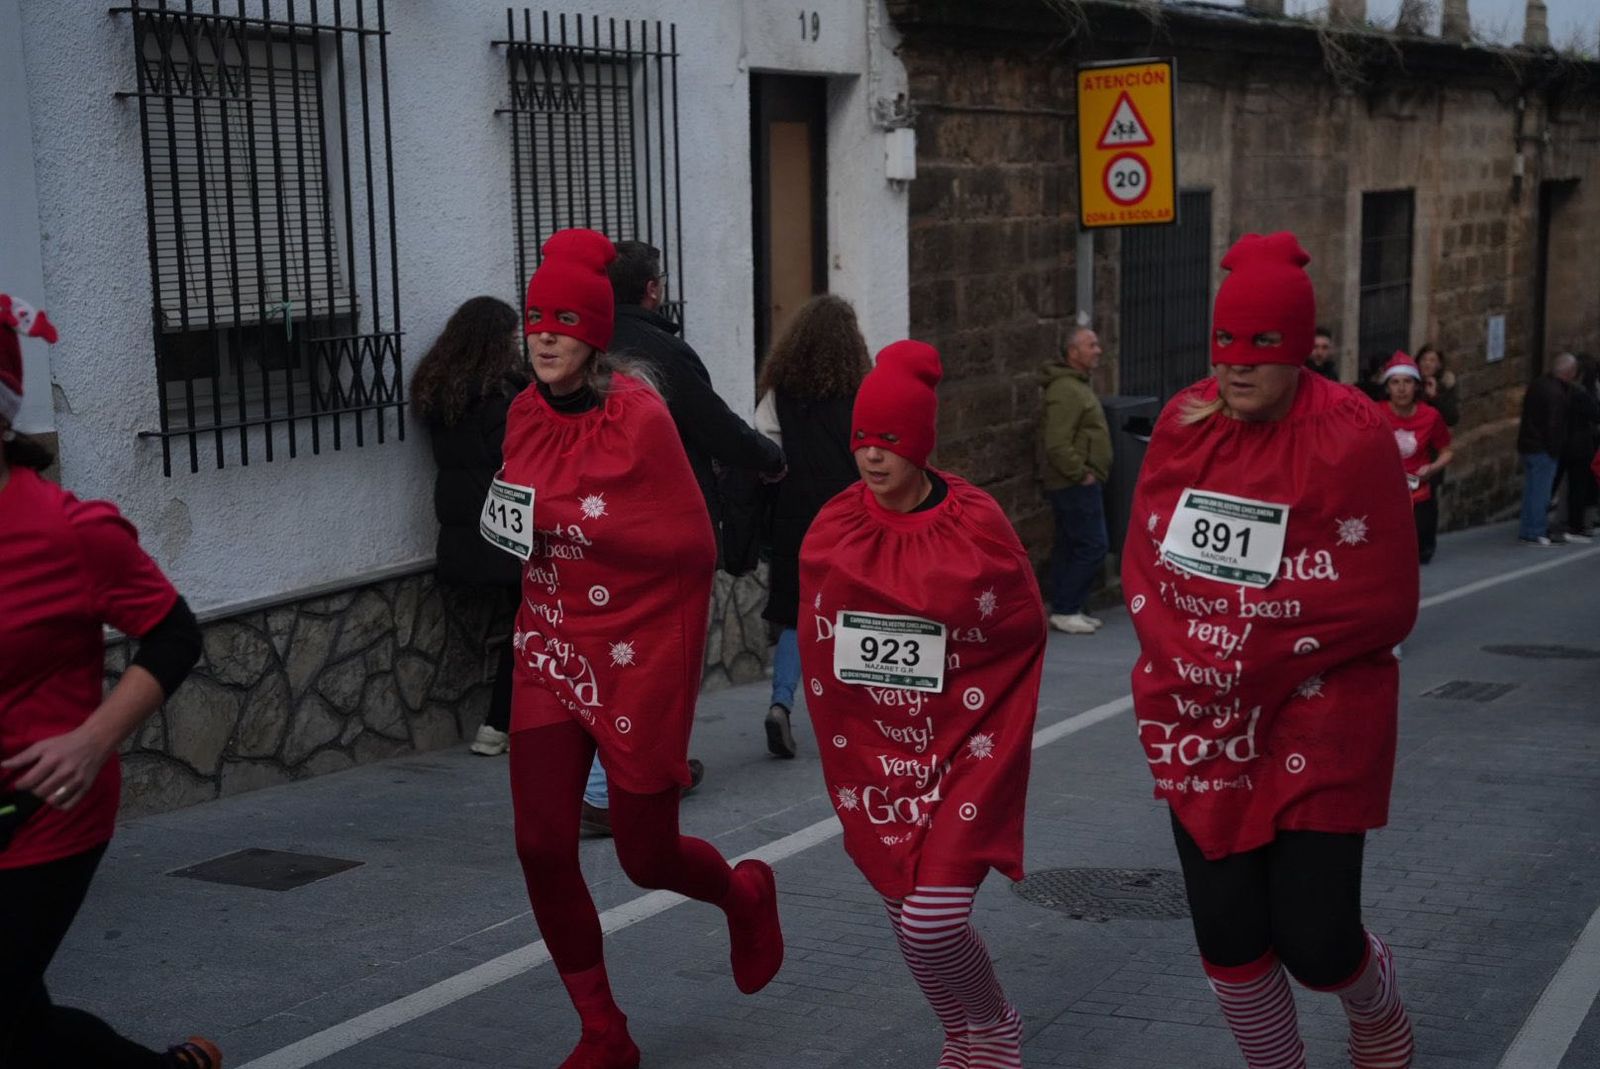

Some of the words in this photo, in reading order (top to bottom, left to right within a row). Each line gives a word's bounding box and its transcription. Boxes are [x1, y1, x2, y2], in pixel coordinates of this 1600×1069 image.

[798, 9, 820, 42] 19
[1084, 67, 1165, 90] ATENCIÓN
[1114, 171, 1141, 188] 20
[1191, 518, 1251, 557] 891
[1276, 548, 1340, 582] nta
[1236, 585, 1302, 618] been
[861, 636, 920, 666] 923
[864, 662, 898, 673] NAZARET
[1138, 705, 1262, 766] Good
